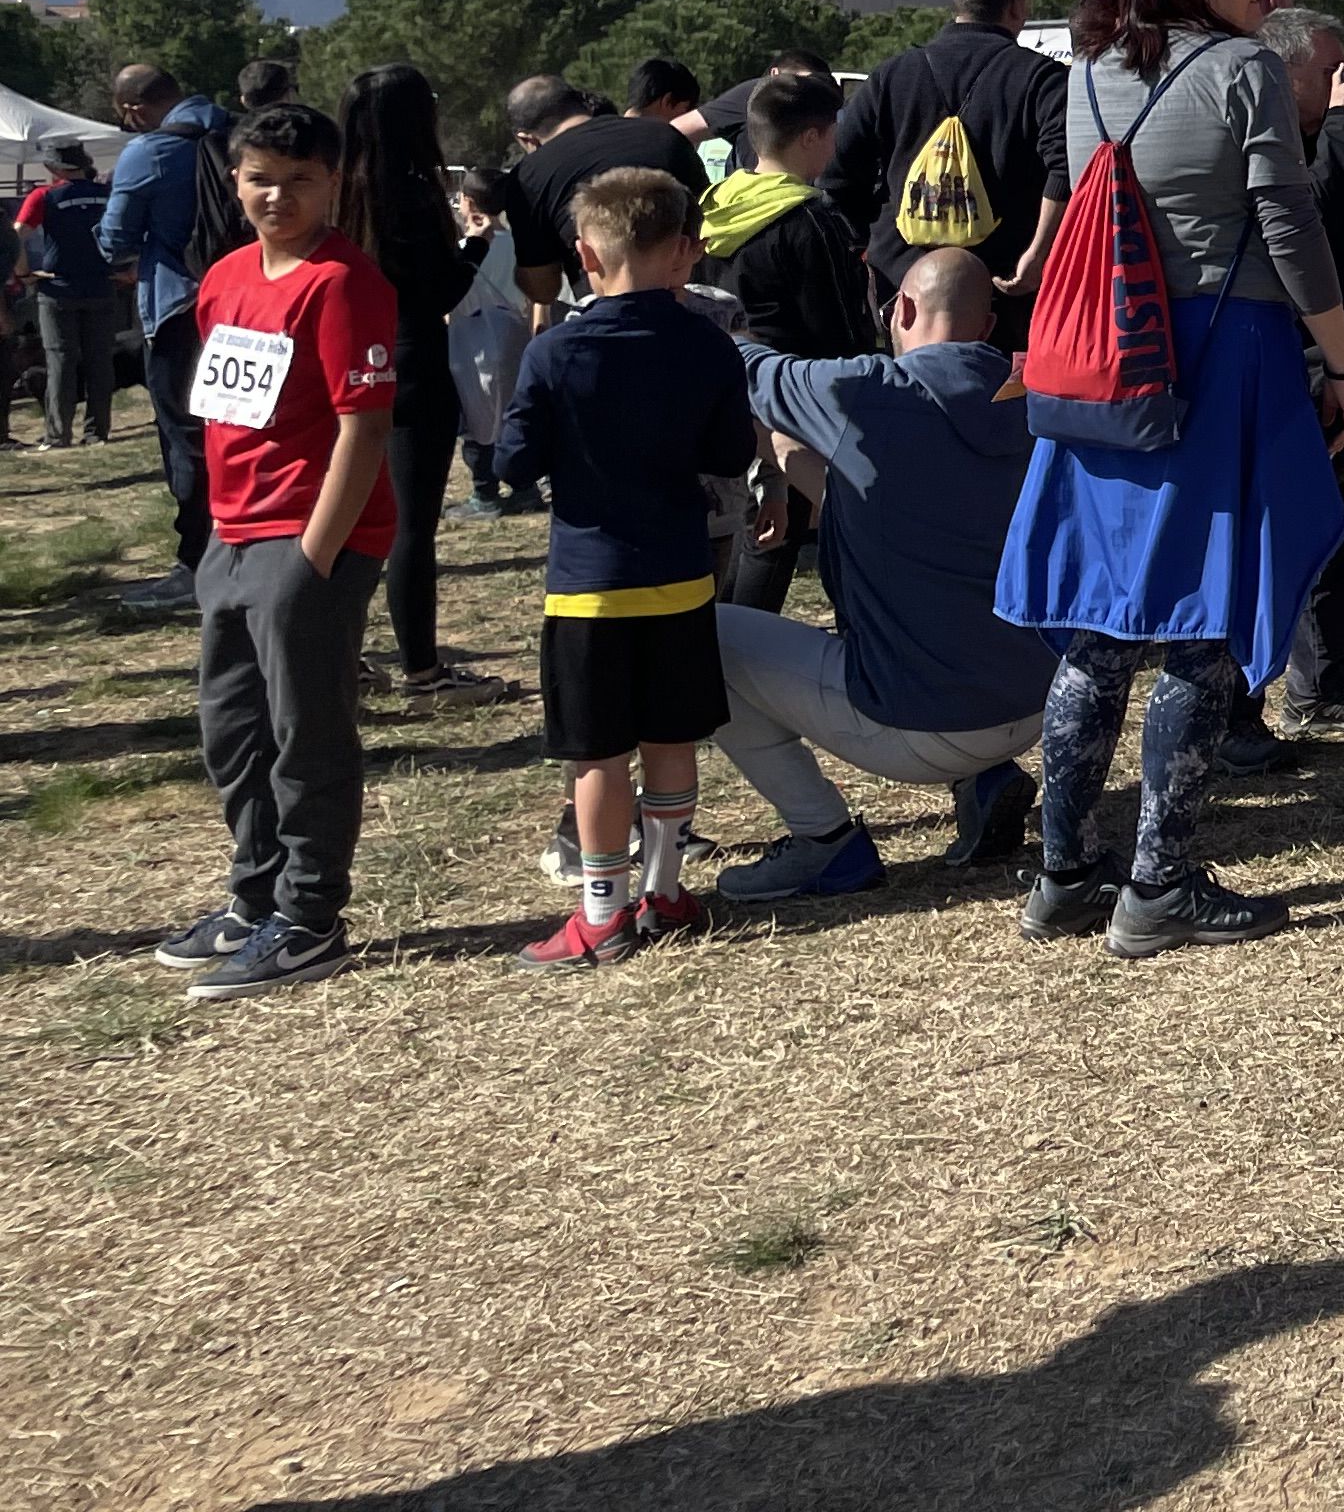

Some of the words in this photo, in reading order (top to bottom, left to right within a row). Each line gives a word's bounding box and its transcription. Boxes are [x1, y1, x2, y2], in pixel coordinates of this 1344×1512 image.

[1114, 276, 1170, 394] JUST
[203, 354, 273, 397] 5054
[590, 879, 614, 898] 9
